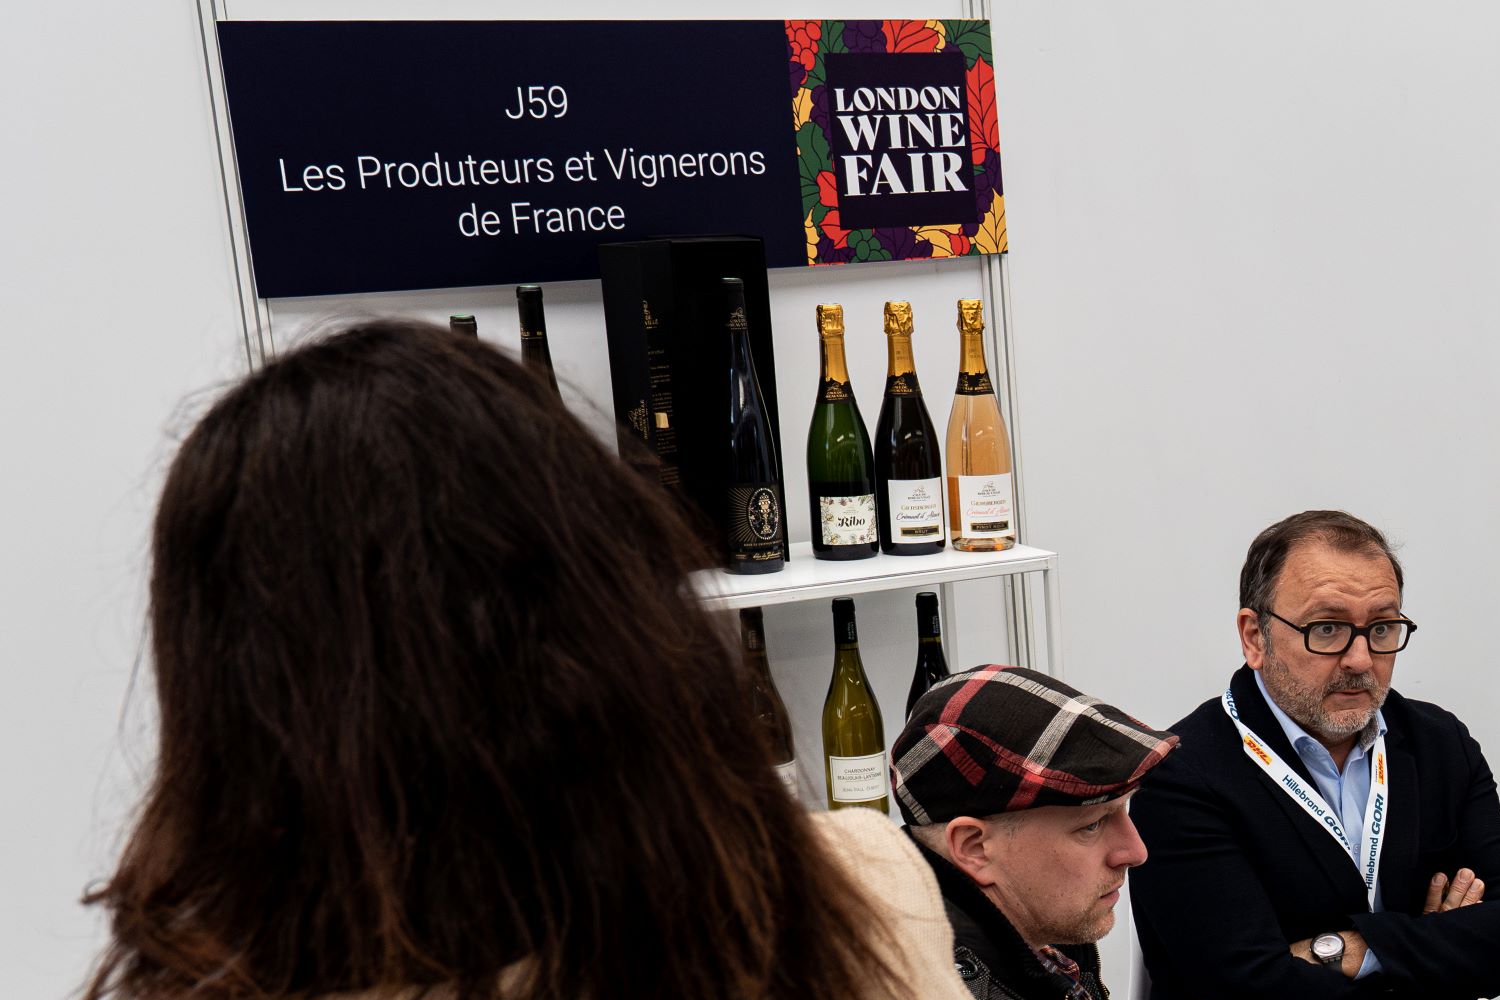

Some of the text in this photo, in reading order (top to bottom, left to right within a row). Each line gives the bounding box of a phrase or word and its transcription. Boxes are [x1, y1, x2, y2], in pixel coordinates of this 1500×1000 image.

[505, 85, 568, 119] J59
[834, 86, 961, 112] LONDON
[836, 112, 966, 151] WINE
[279, 148, 766, 192] Les Produteurs et Vignerons
[840, 152, 969, 197] FAIR
[458, 202, 626, 237] de France
[837, 515, 866, 528] Ribo
[1246, 739, 1269, 765] DHL
[1282, 774, 1326, 817] Hillebrand
[1371, 793, 1384, 835] GORI
[1365, 837, 1379, 890] Hillebrand
